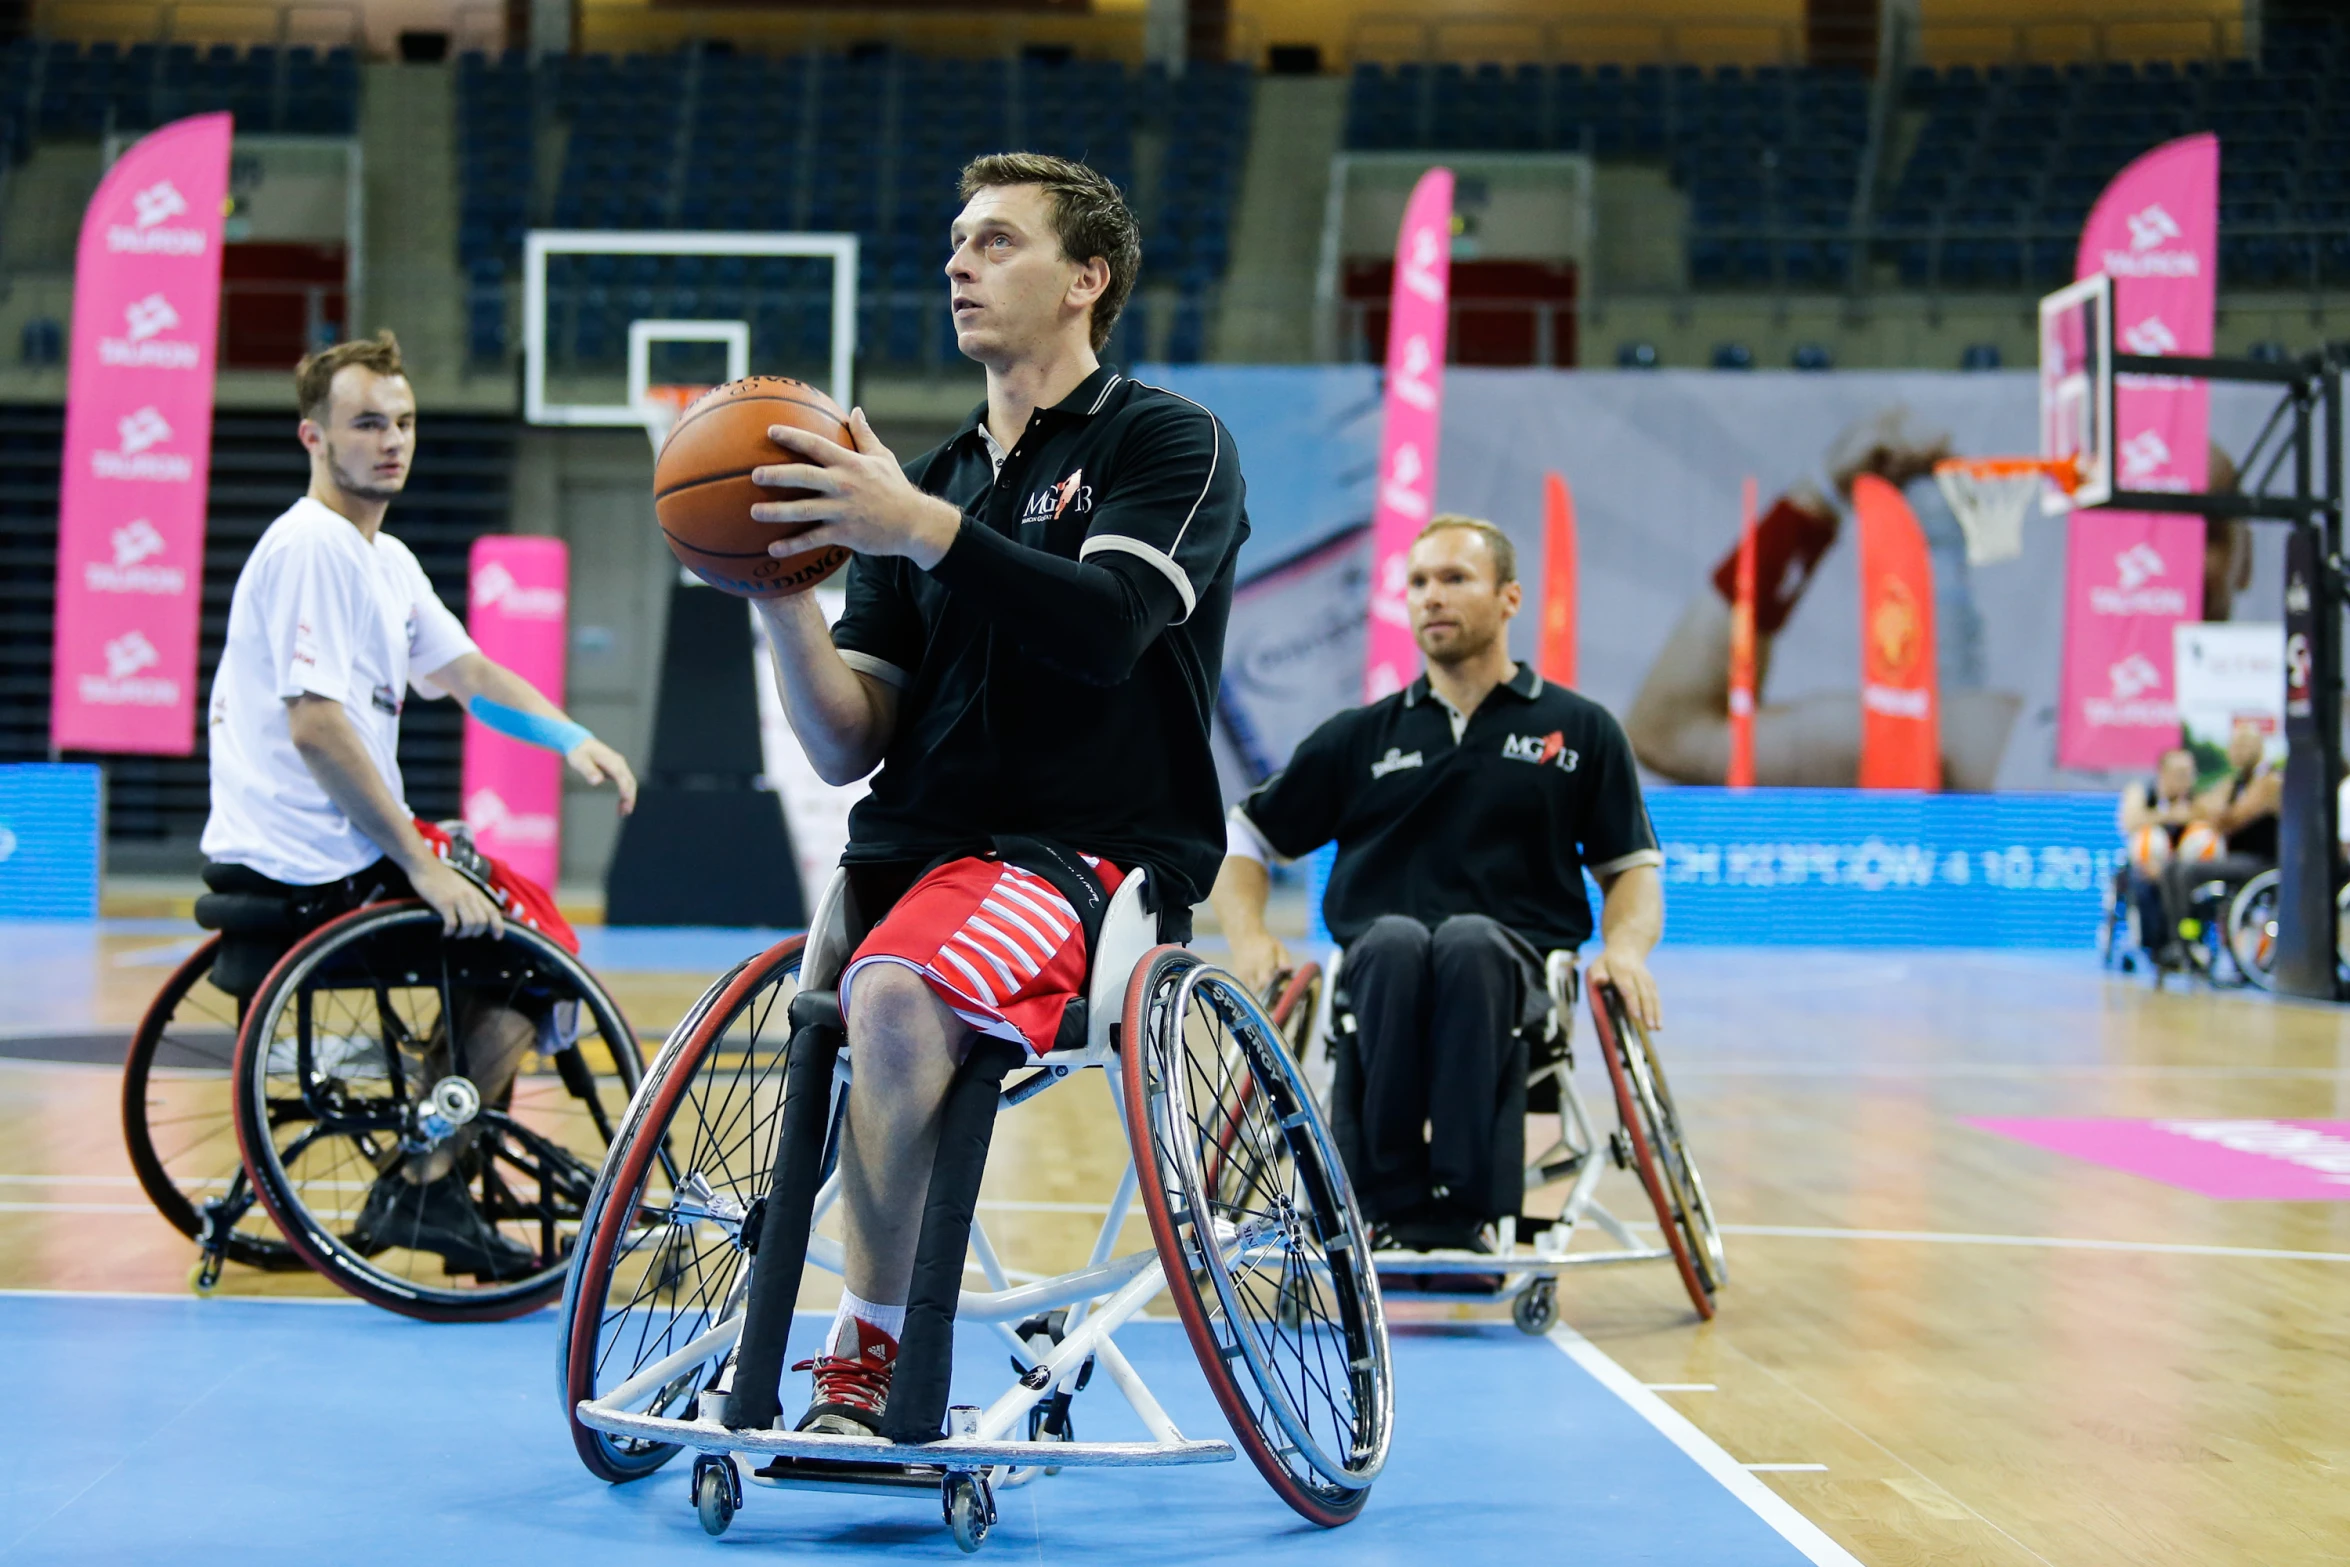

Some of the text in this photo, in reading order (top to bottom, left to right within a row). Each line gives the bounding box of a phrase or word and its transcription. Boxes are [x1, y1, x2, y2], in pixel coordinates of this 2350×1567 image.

[1022, 484, 1093, 516] MG 13
[1555, 747, 1580, 774] 13
